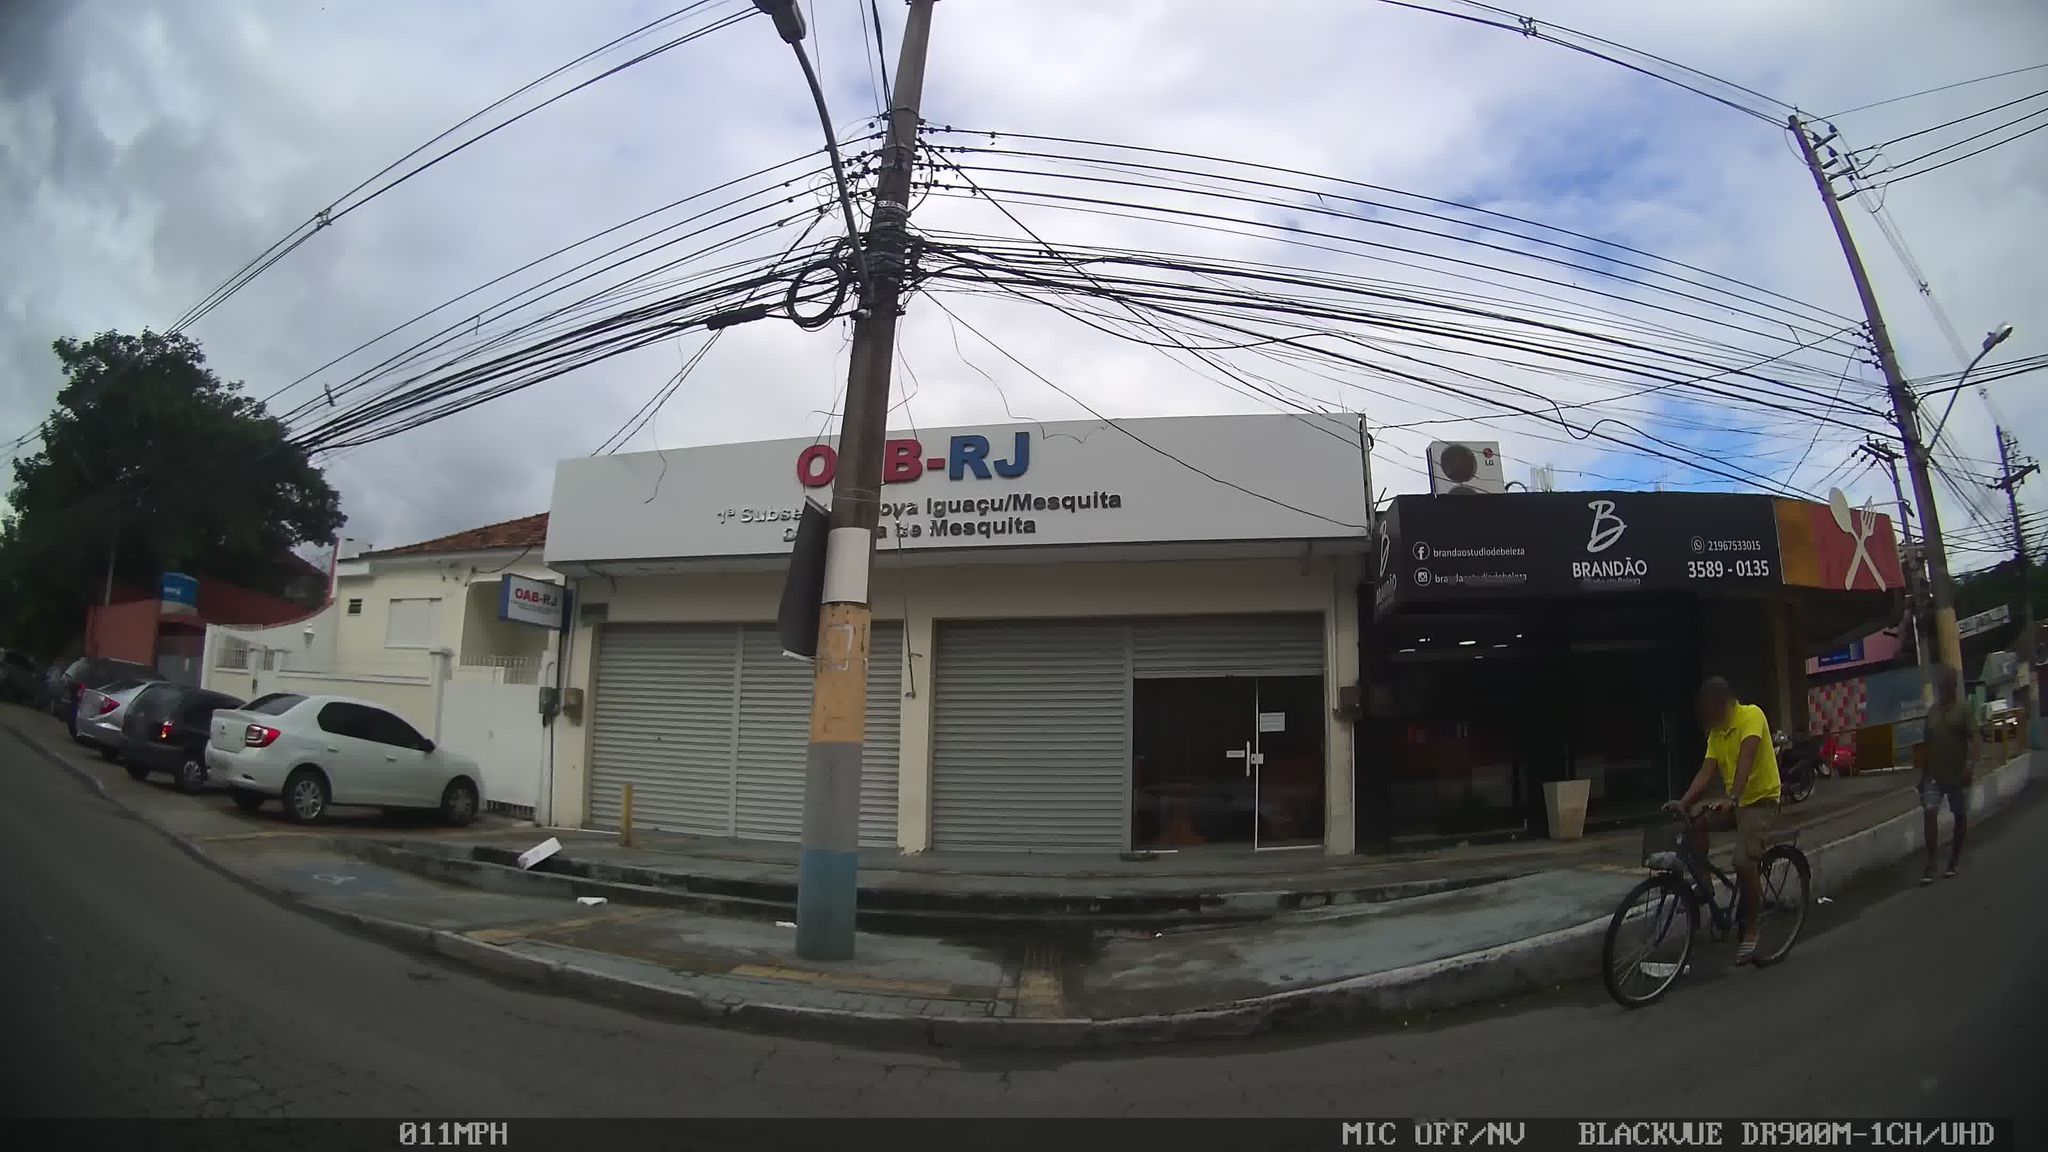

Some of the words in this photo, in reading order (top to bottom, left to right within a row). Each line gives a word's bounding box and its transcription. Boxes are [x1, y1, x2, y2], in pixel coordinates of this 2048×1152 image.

[797, 432, 1029, 487] OB-RJ
[741, 505, 804, 523] Subse
[880, 501, 918, 518] ova
[927, 491, 1122, 518] Iguaçu/Mesquita
[930, 517, 1036, 539] Mesquita
[1587, 500, 1628, 552] B
[1433, 546, 1525, 558] brandaostudiodebeleza
[1707, 540, 1761, 551] 21967533015
[1572, 556, 1648, 578] BRANDÃO
[1687, 560, 1724, 578] 3589
[1736, 560, 1769, 577] 0135
[515, 588, 558, 606] OAB-RJ
